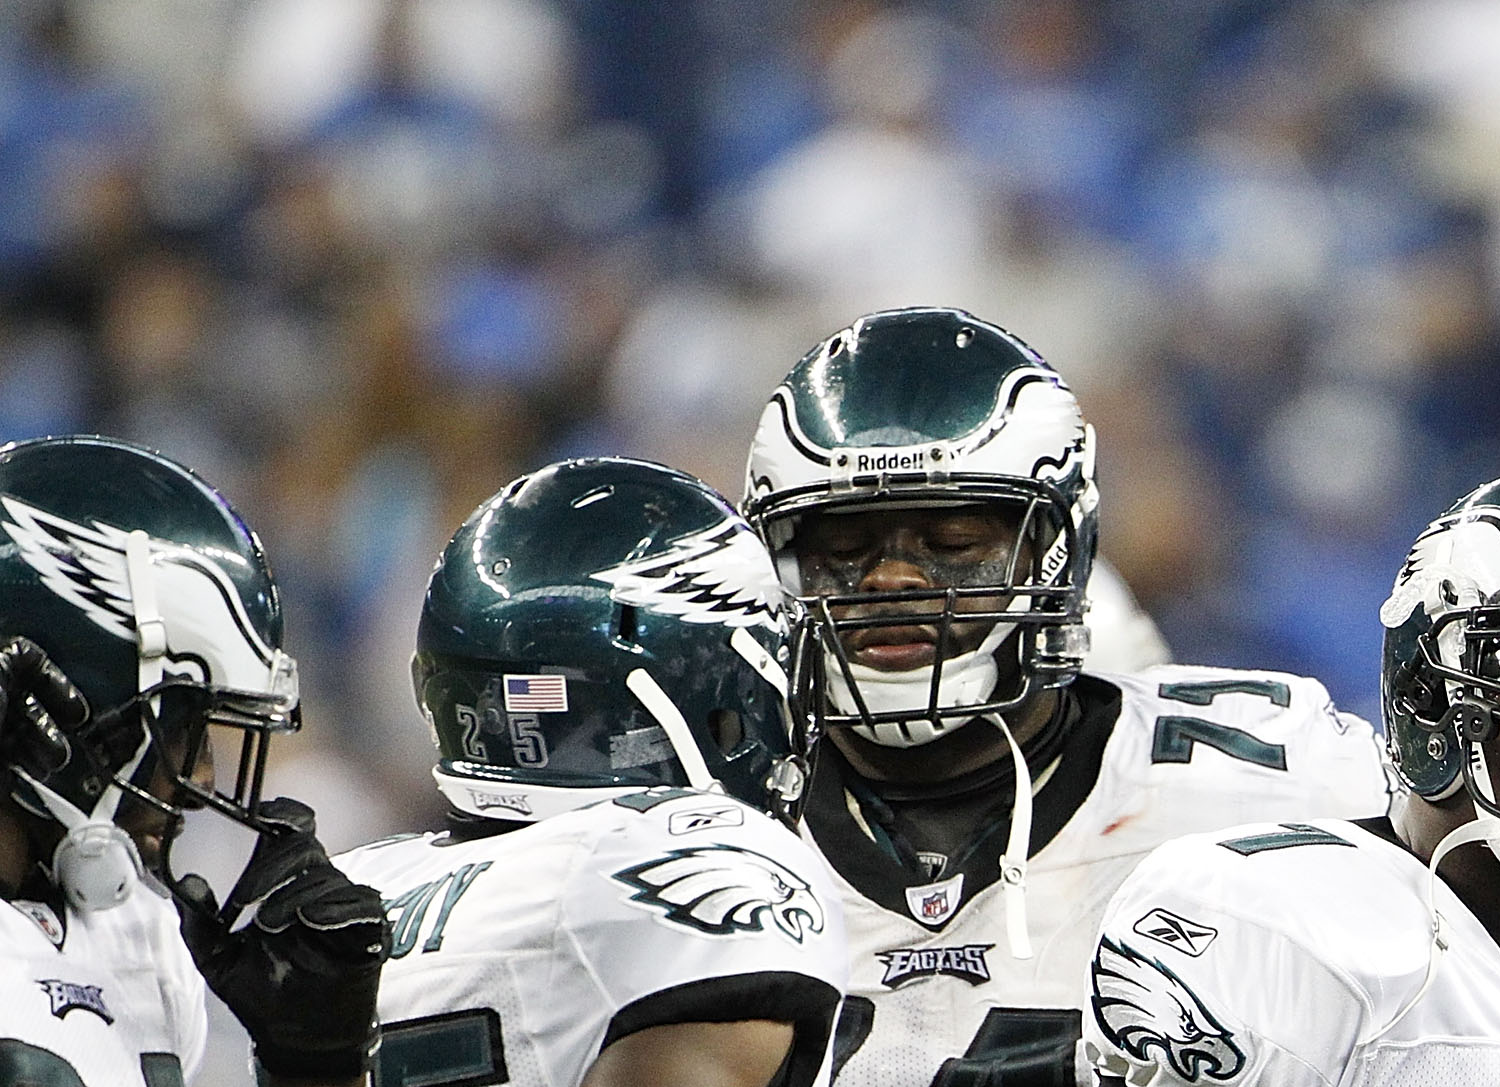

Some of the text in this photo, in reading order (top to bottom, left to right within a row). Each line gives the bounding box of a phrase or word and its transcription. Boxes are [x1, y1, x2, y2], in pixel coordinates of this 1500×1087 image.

[857, 452, 924, 472] Riddell
[1151, 679, 1291, 772] 71
[883, 947, 991, 984] EAGLES
